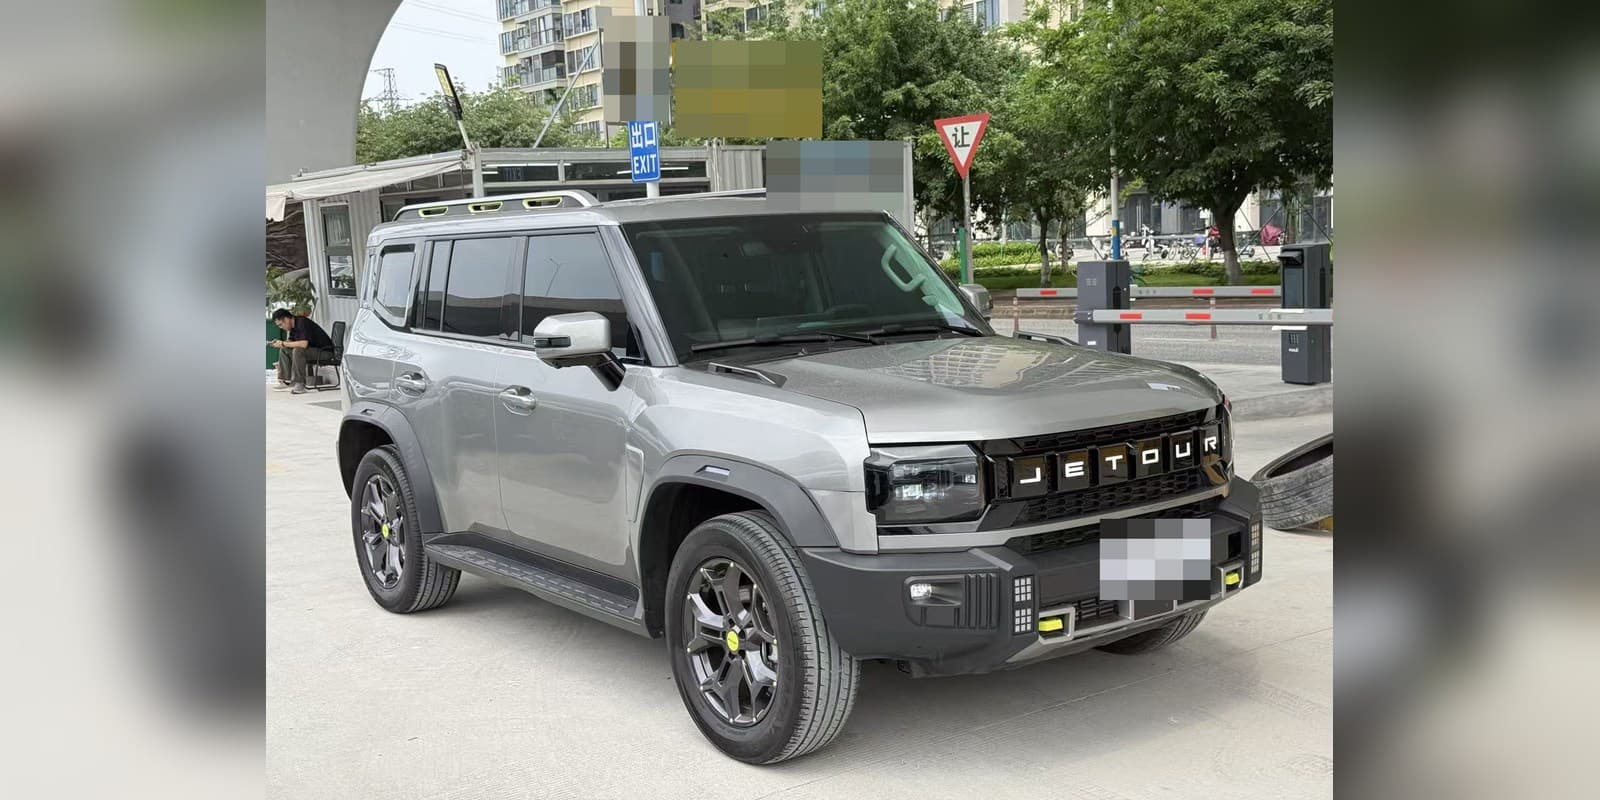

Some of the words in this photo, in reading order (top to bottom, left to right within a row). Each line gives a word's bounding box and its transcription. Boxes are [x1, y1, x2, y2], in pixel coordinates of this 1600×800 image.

[631, 122, 656, 149] 出口
[951, 125, 971, 148] 让
[633, 153, 657, 174] EXIT
[1019, 436, 1217, 484] JETOUR
